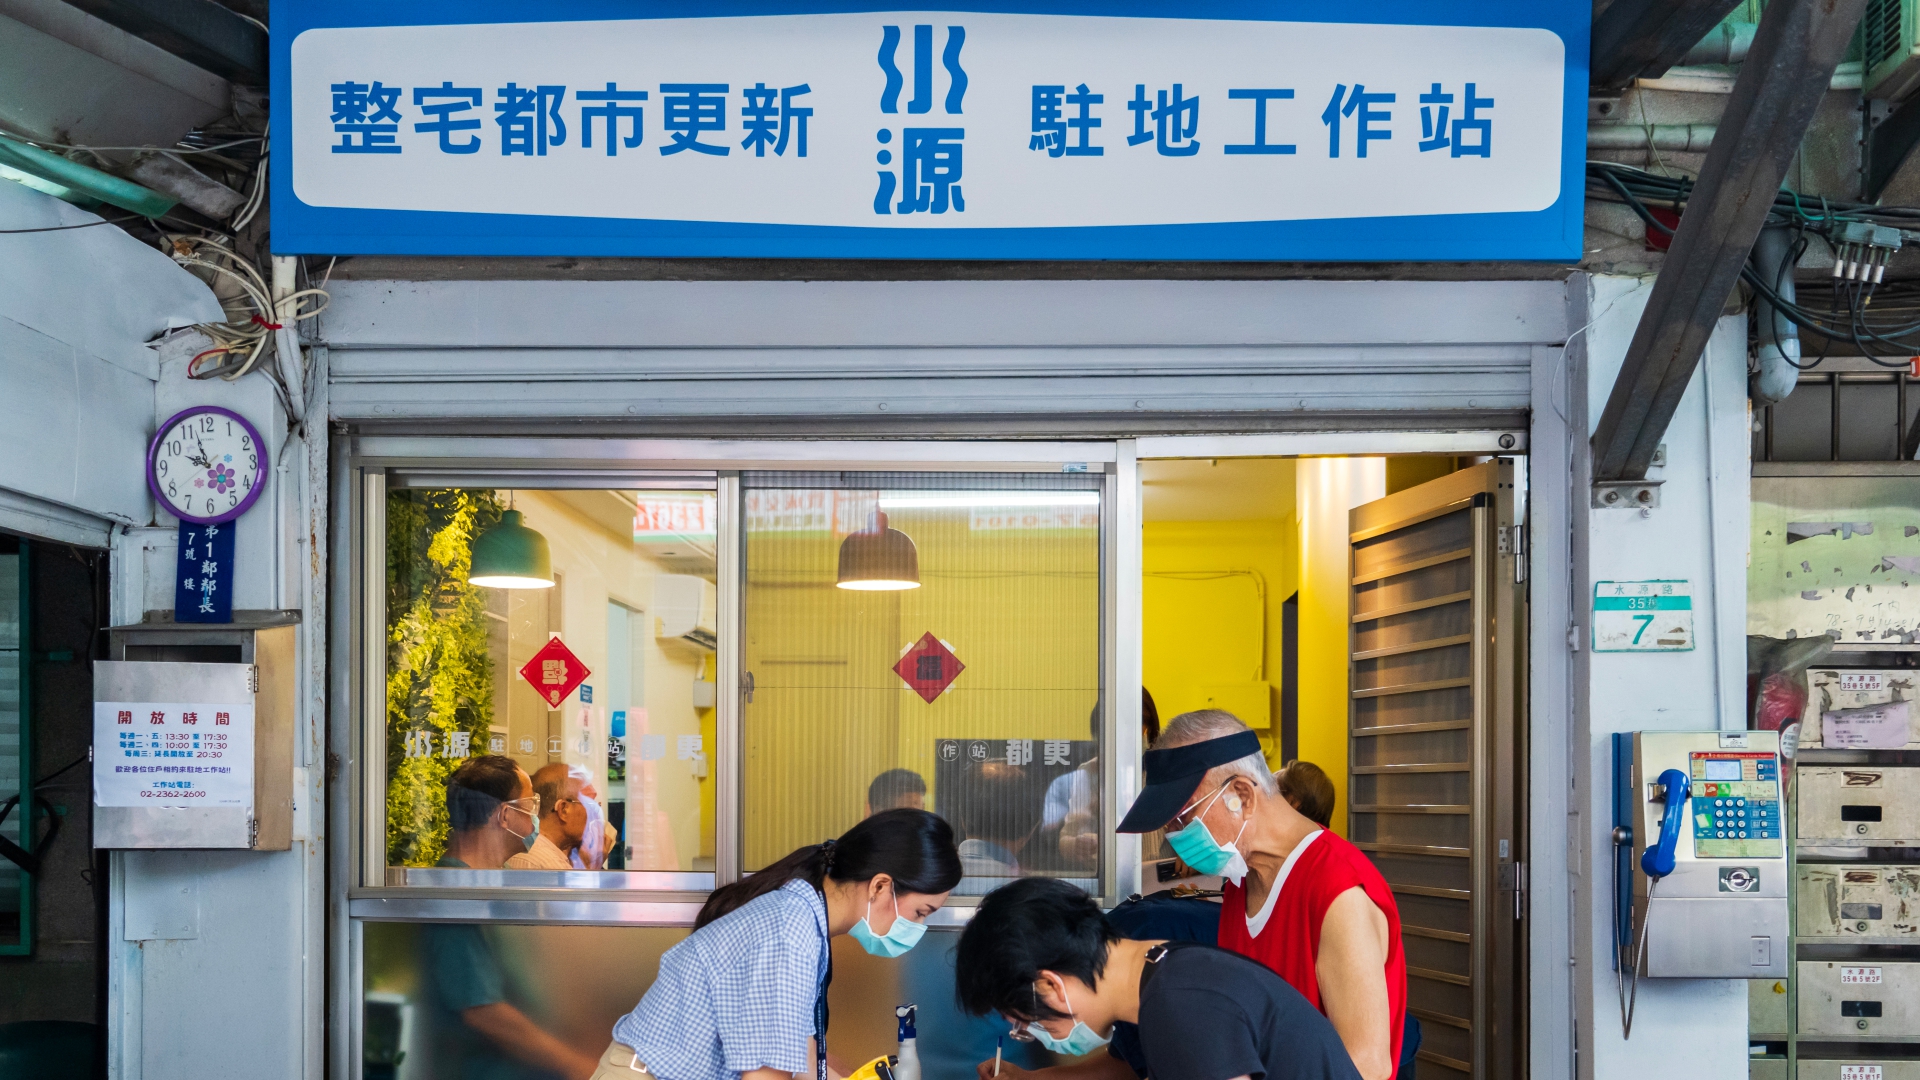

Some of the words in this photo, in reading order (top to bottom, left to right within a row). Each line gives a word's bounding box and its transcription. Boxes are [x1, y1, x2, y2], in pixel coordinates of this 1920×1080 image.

[330, 81, 814, 158] 整宅都市更新
[873, 25, 968, 215] 水源
[1029, 82, 1495, 158] 駐地工作站
[180, 424, 194, 440] 11
[199, 417, 214, 433] 12
[225, 421, 232, 437] 1
[166, 440, 182, 457] 10
[242, 435, 251, 451] 2
[160, 460, 168, 478] 9
[249, 455, 257, 470] 3
[168, 482, 177, 498] 8
[242, 475, 251, 490] 4
[184, 495, 192, 510] 7
[206, 498, 215, 514] 6
[229, 490, 238, 507] 5
[1614, 584, 1673, 595] 水源路
[1628, 598, 1657, 610] 35巷
[1632, 614, 1655, 645] 7
[117, 711, 230, 726] 開放時間
[404, 731, 471, 758] 水源
[1005, 739, 1071, 766] 都更
[140, 790, 206, 798] 02-2362-2600
